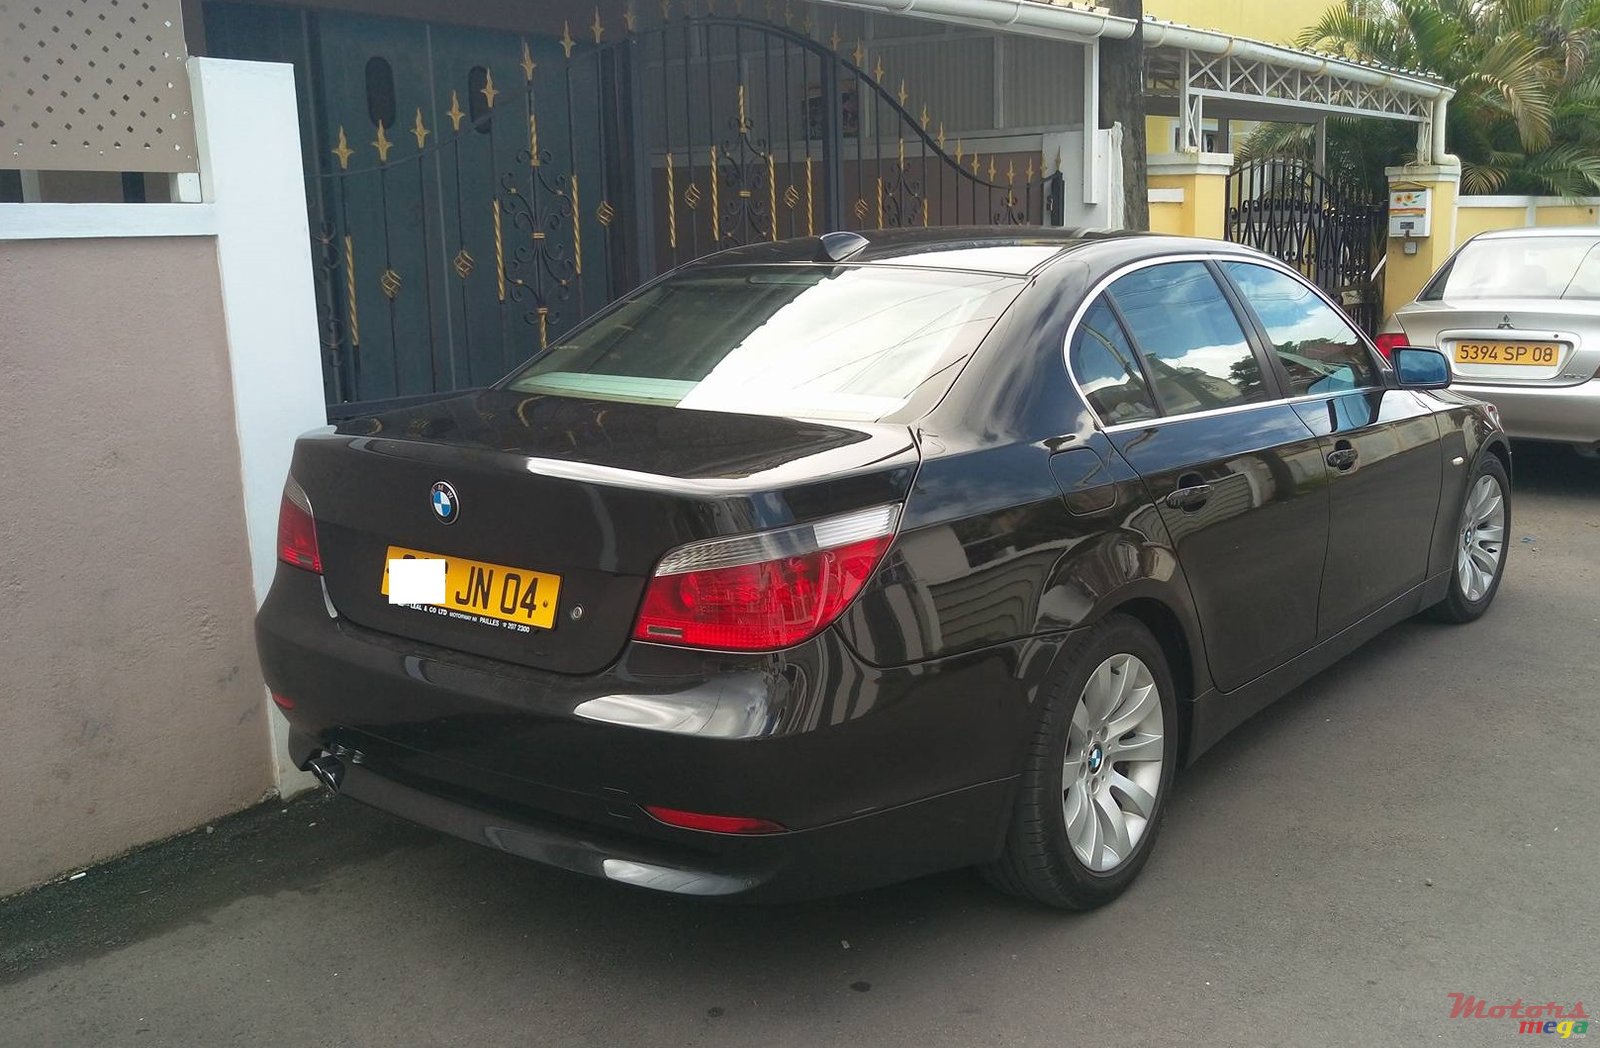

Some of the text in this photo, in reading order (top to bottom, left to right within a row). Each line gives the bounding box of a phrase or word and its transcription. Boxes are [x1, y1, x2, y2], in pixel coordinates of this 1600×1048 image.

[1460, 344, 1553, 362] 5394 SP 08
[455, 565, 494, 609] JN
[500, 572, 539, 619] 04
[438, 607, 448, 616] LTD
[480, 616, 499, 627] PAILLES
